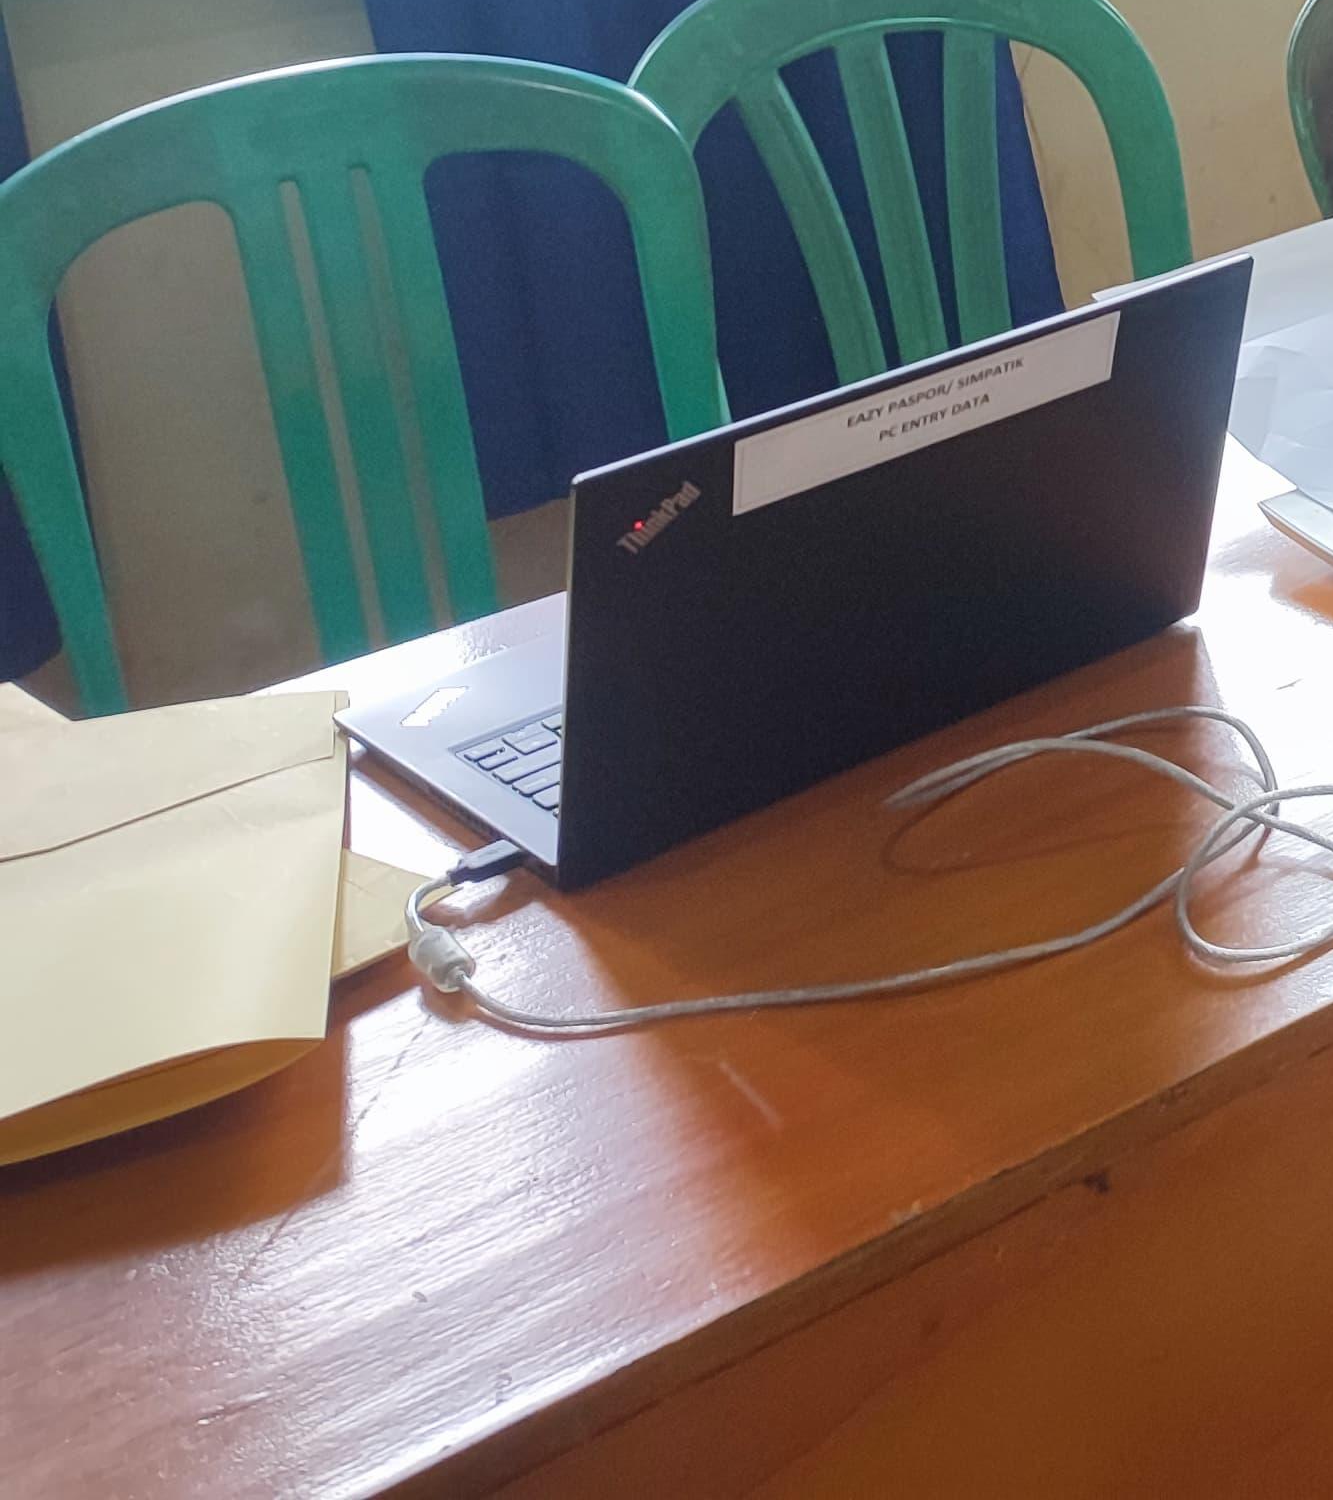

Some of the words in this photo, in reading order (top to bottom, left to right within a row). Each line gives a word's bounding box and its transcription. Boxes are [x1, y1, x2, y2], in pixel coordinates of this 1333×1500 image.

[847, 407, 884, 428] EAZY
[888, 382, 954, 414] PASPOR/
[957, 357, 1024, 389] SIMPATIK
[879, 426, 896, 441] PC
[902, 409, 947, 434] ENTRY
[952, 394, 990, 416] DATA
[616, 481, 701, 555] ThinkPad
